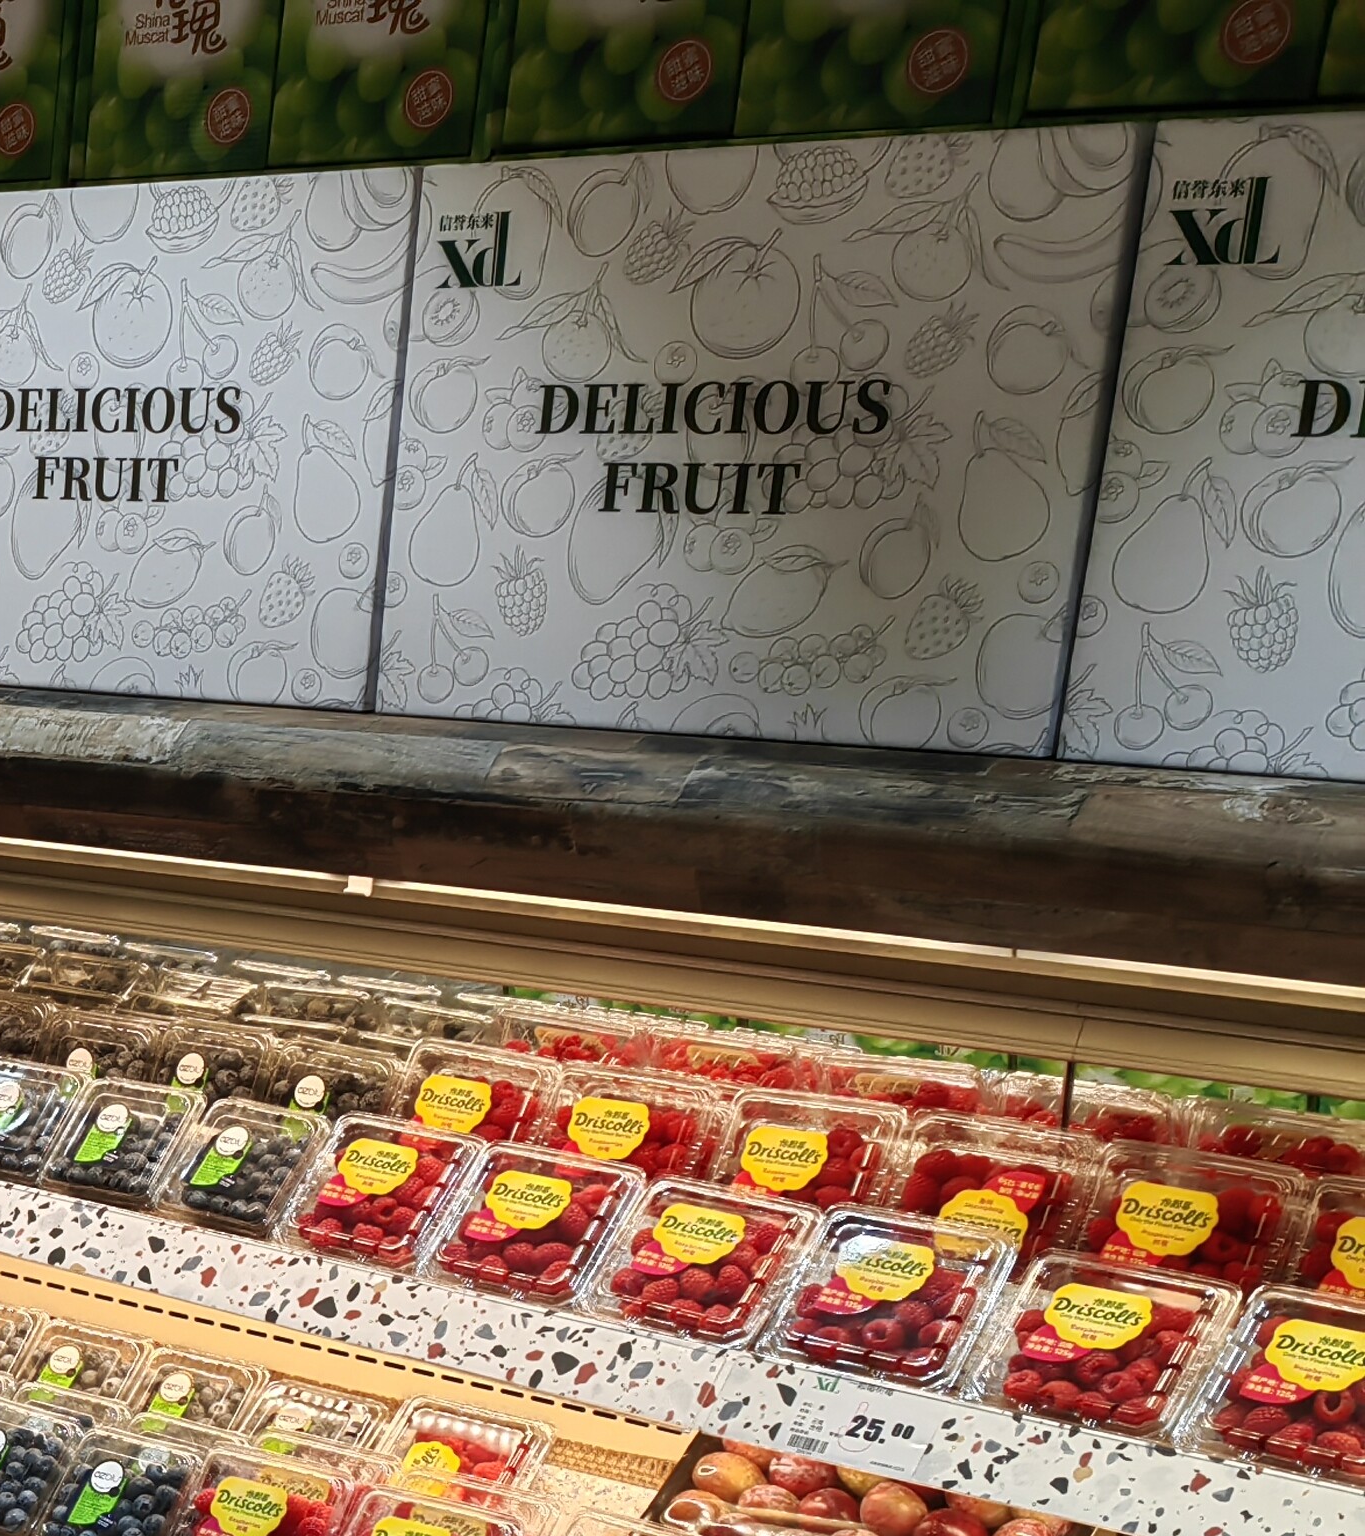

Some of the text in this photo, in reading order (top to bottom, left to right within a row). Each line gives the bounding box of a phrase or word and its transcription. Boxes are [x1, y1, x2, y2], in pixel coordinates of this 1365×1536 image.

[135, 13, 169, 30] Shina
[315, 9, 366, 26] Muscat
[124, 30, 169, 46] Muscat
[1172, 178, 1246, 200] 信誉东来
[438, 213, 494, 233] 信誉东来
[535, 379, 890, 436] DELICIOUS
[31, 456, 180, 502] FRUIT
[596, 462, 800, 516] FRUIT
[423, 1087, 491, 1113] Driscoll's
[576, 1112, 649, 1137] Driscoll's
[345, 1149, 411, 1175] Driscoll's
[748, 1141, 823, 1166] Driscoll's
[494, 1183, 568, 1209] Driscoll's
[1124, 1199, 1214, 1228] Driscoll's
[664, 1216, 739, 1243] Driscoll's
[1053, 1297, 1143, 1327] Driscoll's
[845, 1415, 915, 1444] 25.00
[217, 1490, 283, 1517] Driscoll's
